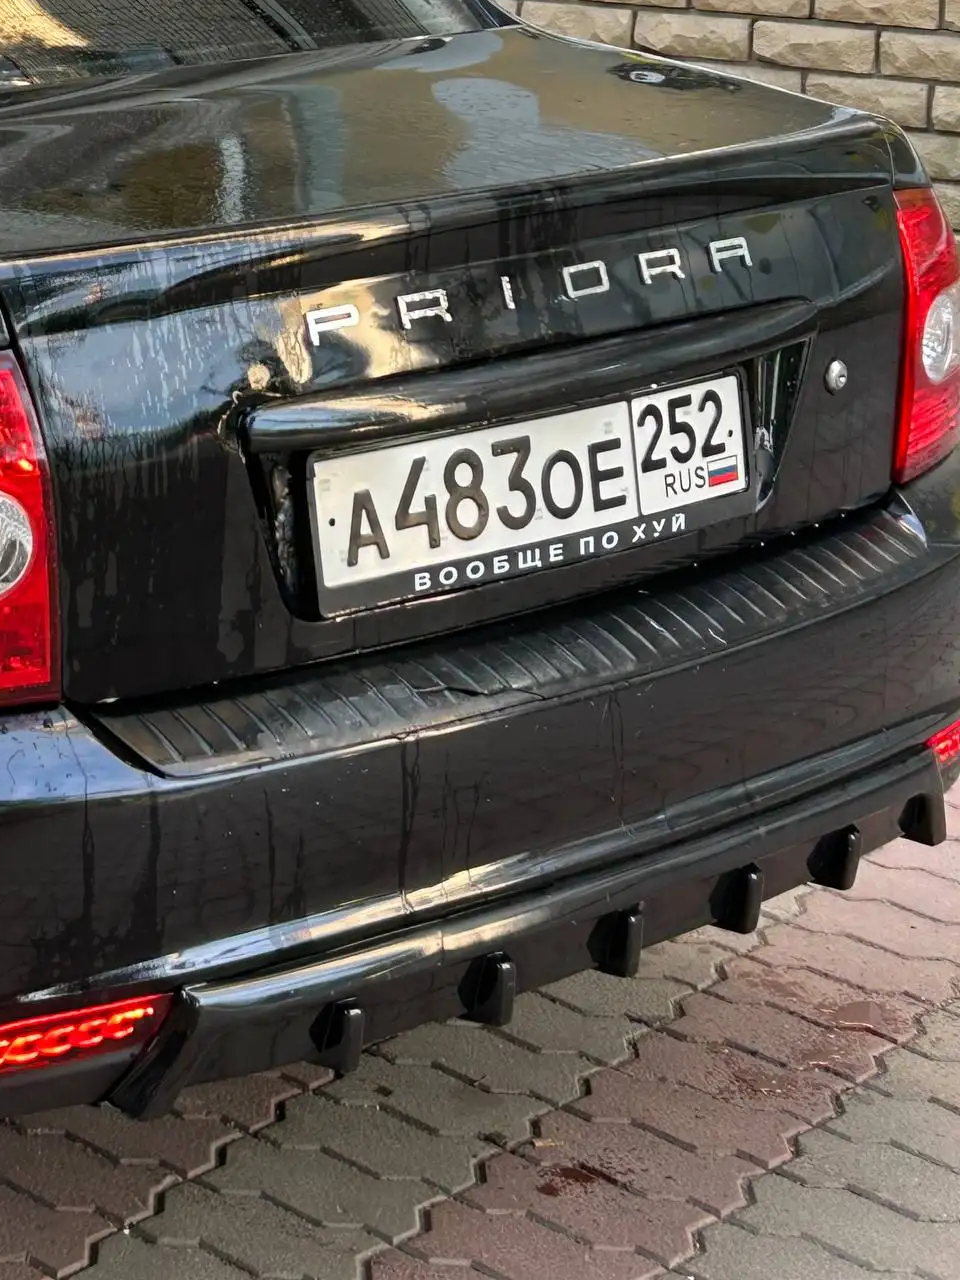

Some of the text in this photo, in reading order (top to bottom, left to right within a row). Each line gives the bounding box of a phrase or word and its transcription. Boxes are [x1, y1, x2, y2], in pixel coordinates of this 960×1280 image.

[305, 236, 753, 347] PRIORA
[347, 389, 726, 568] А483ОЕ 252
[664, 466, 706, 498] RUS
[414, 513, 686, 591] ВООБЩЕ ПО ХУЙ
